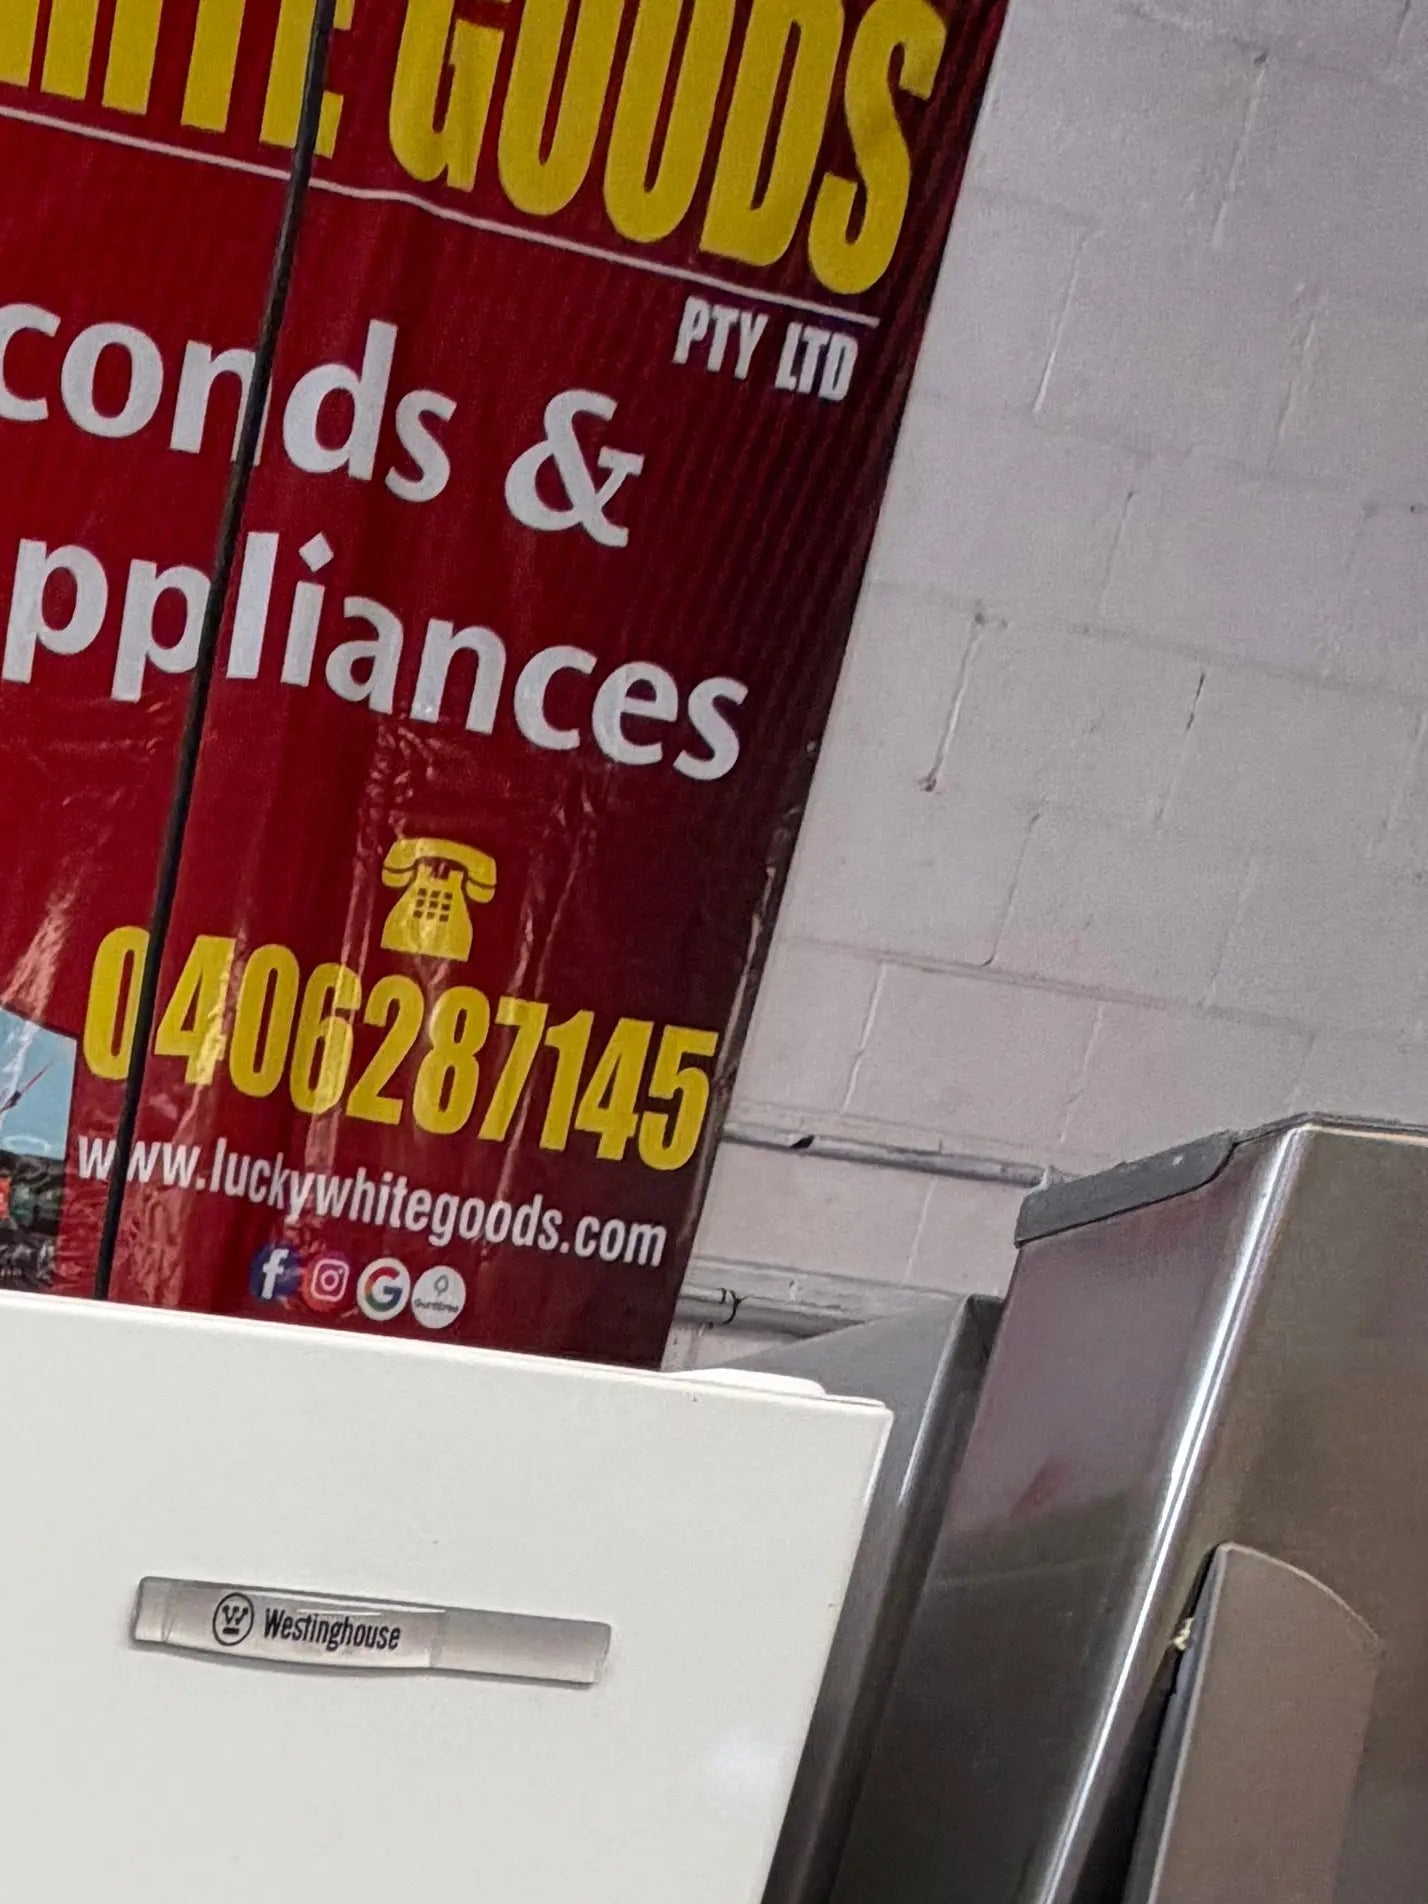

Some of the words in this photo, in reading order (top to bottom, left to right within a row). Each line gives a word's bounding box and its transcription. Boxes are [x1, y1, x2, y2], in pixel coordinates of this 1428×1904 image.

[388, 0, 947, 296] GOODS
[672, 294, 770, 381] PTY
[774, 320, 861, 403] LTD
[503, 388, 645, 549] &
[84, 926, 720, 1172] 0406287145
[76, 1132, 669, 1268] www.luckywhitegoods.com
[263, 1606, 402, 1653] Westinghouse
